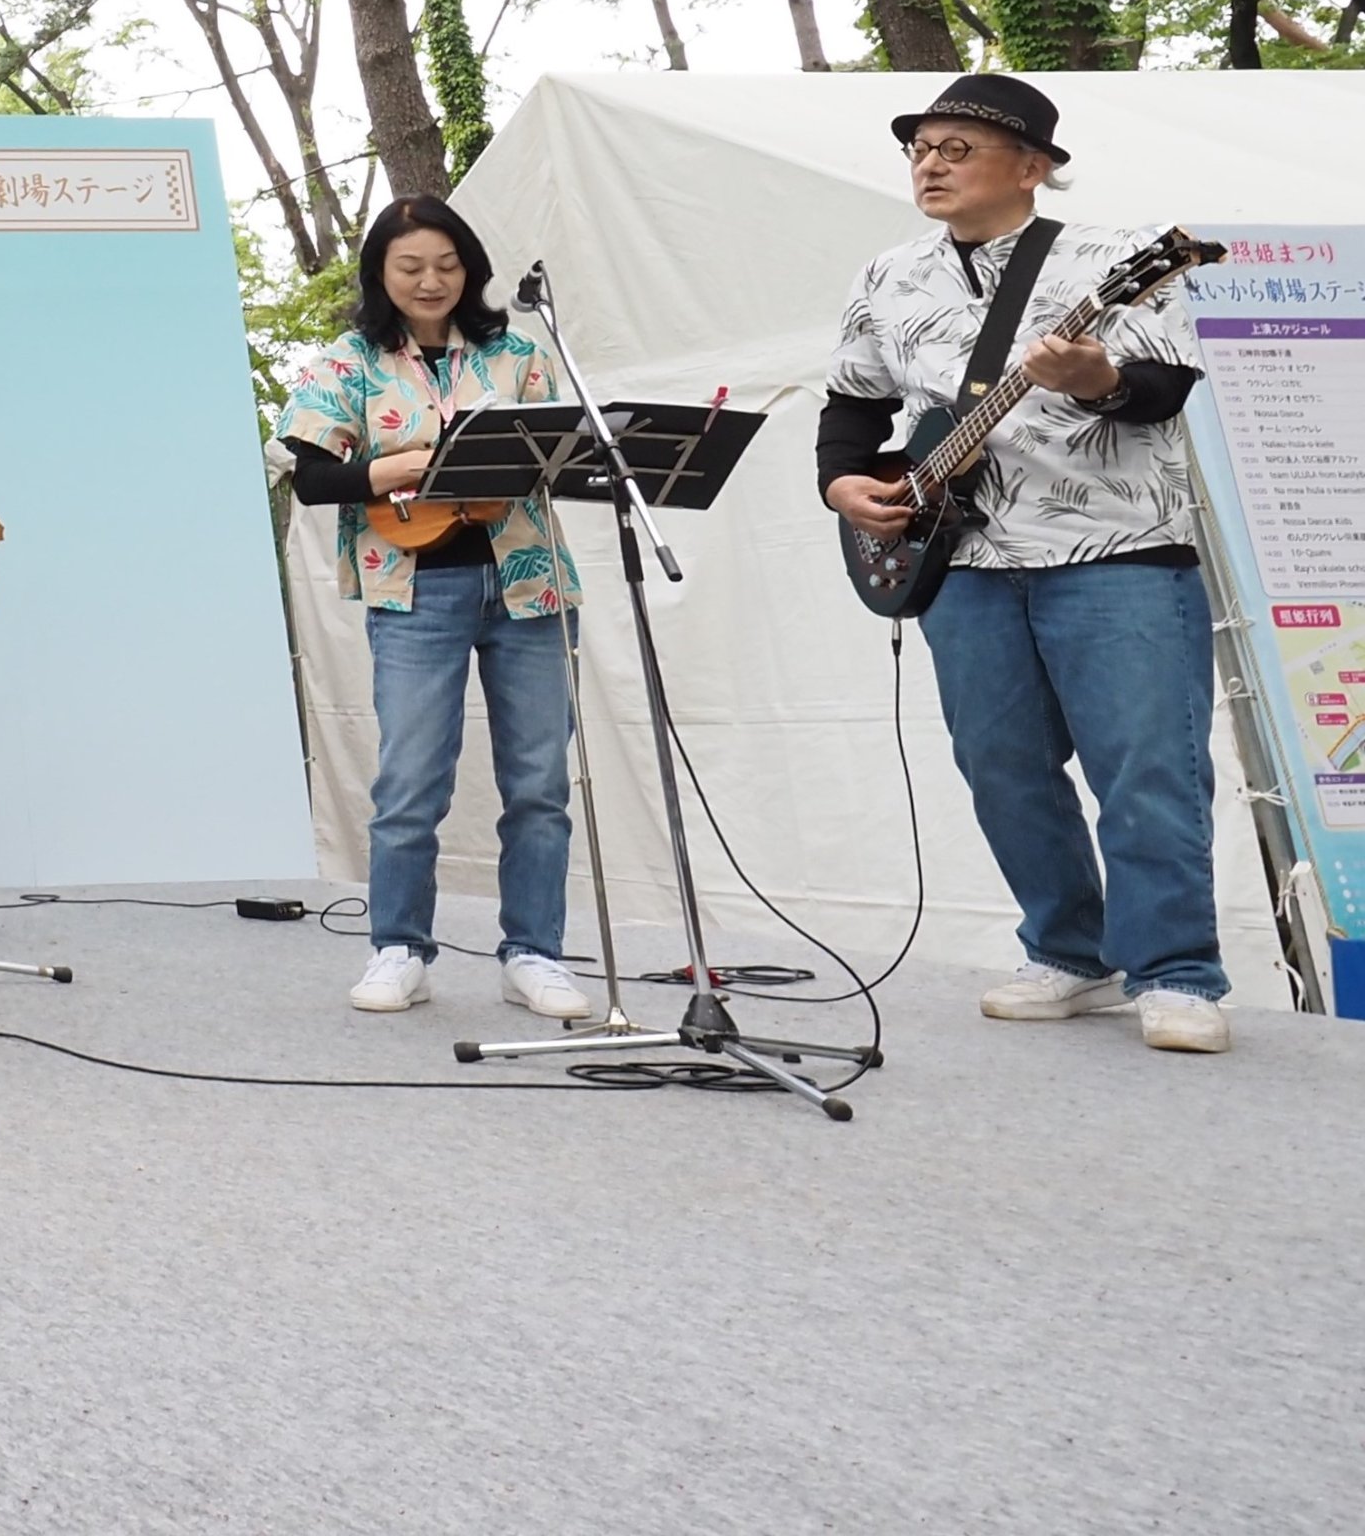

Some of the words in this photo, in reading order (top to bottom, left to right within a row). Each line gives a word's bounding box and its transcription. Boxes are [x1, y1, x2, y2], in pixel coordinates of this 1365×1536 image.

[1231, 240, 1334, 264] 照姫まつり
[1251, 322, 1331, 336] 上演スケジュール
[1279, 608, 1334, 625] 照姫行列
